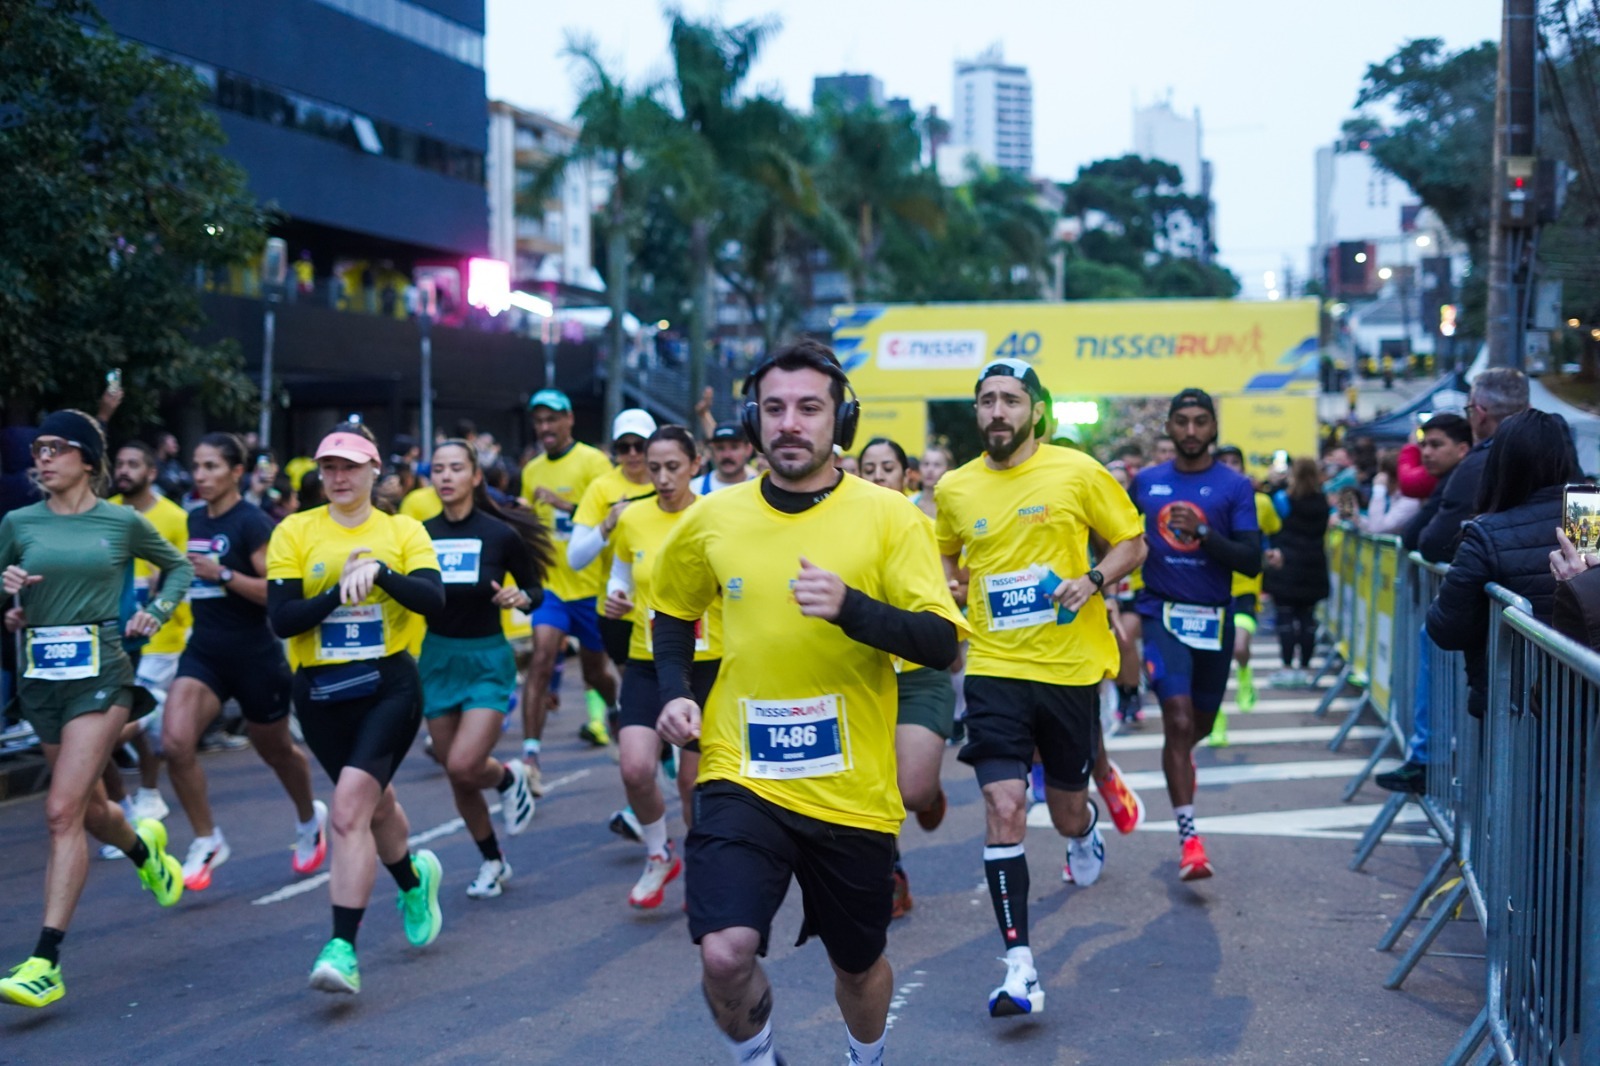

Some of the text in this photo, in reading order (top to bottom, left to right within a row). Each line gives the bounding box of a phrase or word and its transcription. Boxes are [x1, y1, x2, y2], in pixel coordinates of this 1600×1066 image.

[994, 331, 1042, 359] 40
[1002, 587, 1036, 608] 2046
[345, 624, 359, 639] 16
[44, 643, 77, 660] 2069
[767, 725, 818, 748] 1486
